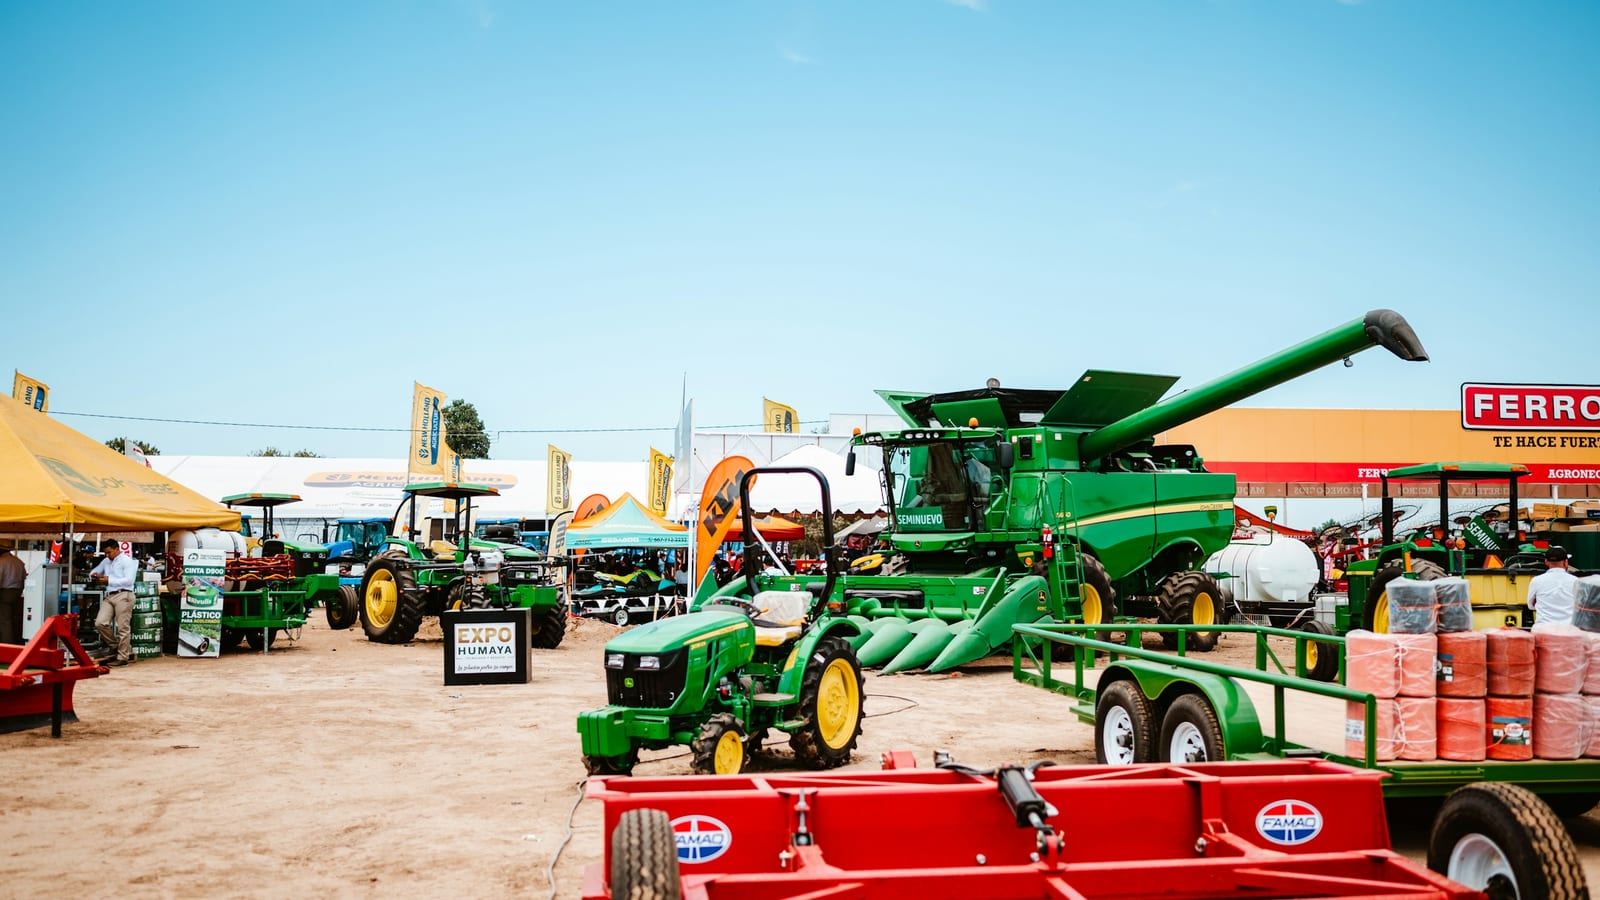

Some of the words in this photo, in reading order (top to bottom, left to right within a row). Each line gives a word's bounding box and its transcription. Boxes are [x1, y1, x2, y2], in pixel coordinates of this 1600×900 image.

[1473, 393, 1600, 420] FERRO
[423, 397, 431, 430] HOLLAND
[421, 430, 429, 448] NEW
[1493, 436, 1512, 448] TE
[1516, 436, 1557, 448] HACE
[1358, 468, 1394, 478] FERR
[703, 469, 745, 537] KTM
[897, 514, 943, 525] SEMINUEVO
[184, 567, 204, 575] CINTA
[181, 610, 221, 619] PLÁSTICO
[458, 627, 512, 643] EXPO
[458, 646, 512, 655] HUMAYA
[674, 833, 724, 845] AMAQ
